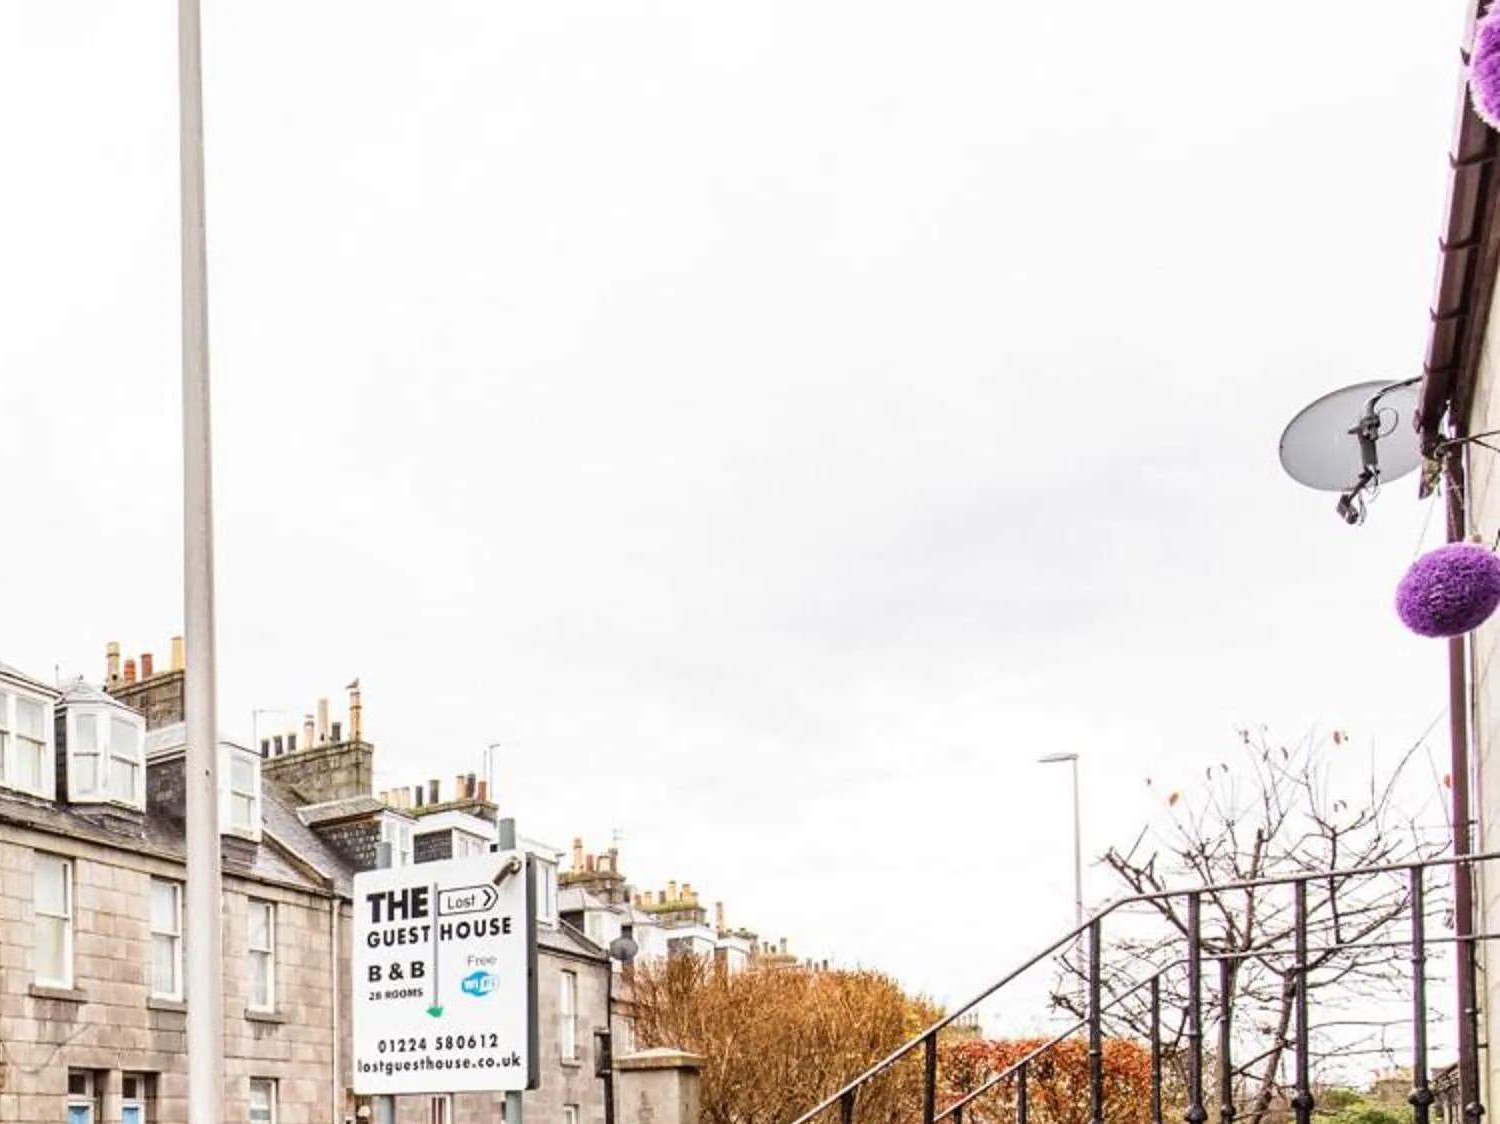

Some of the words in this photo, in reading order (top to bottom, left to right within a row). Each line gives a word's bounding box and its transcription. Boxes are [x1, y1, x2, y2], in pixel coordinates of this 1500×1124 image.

[366, 886, 429, 923] THE
[447, 894, 476, 910] Lost
[367, 925, 431, 948] GUEST
[440, 917, 512, 941] HOUSE
[368, 965, 382, 982] B
[389, 962, 404, 980] &
[411, 960, 425, 979] B
[467, 954, 498, 967] Free
[385, 988, 423, 999] ROOMS
[378, 1038, 428, 1053] 01224
[435, 1033, 499, 1050] 580612
[357, 1051, 521, 1076] lostguesthouse.co.uk
